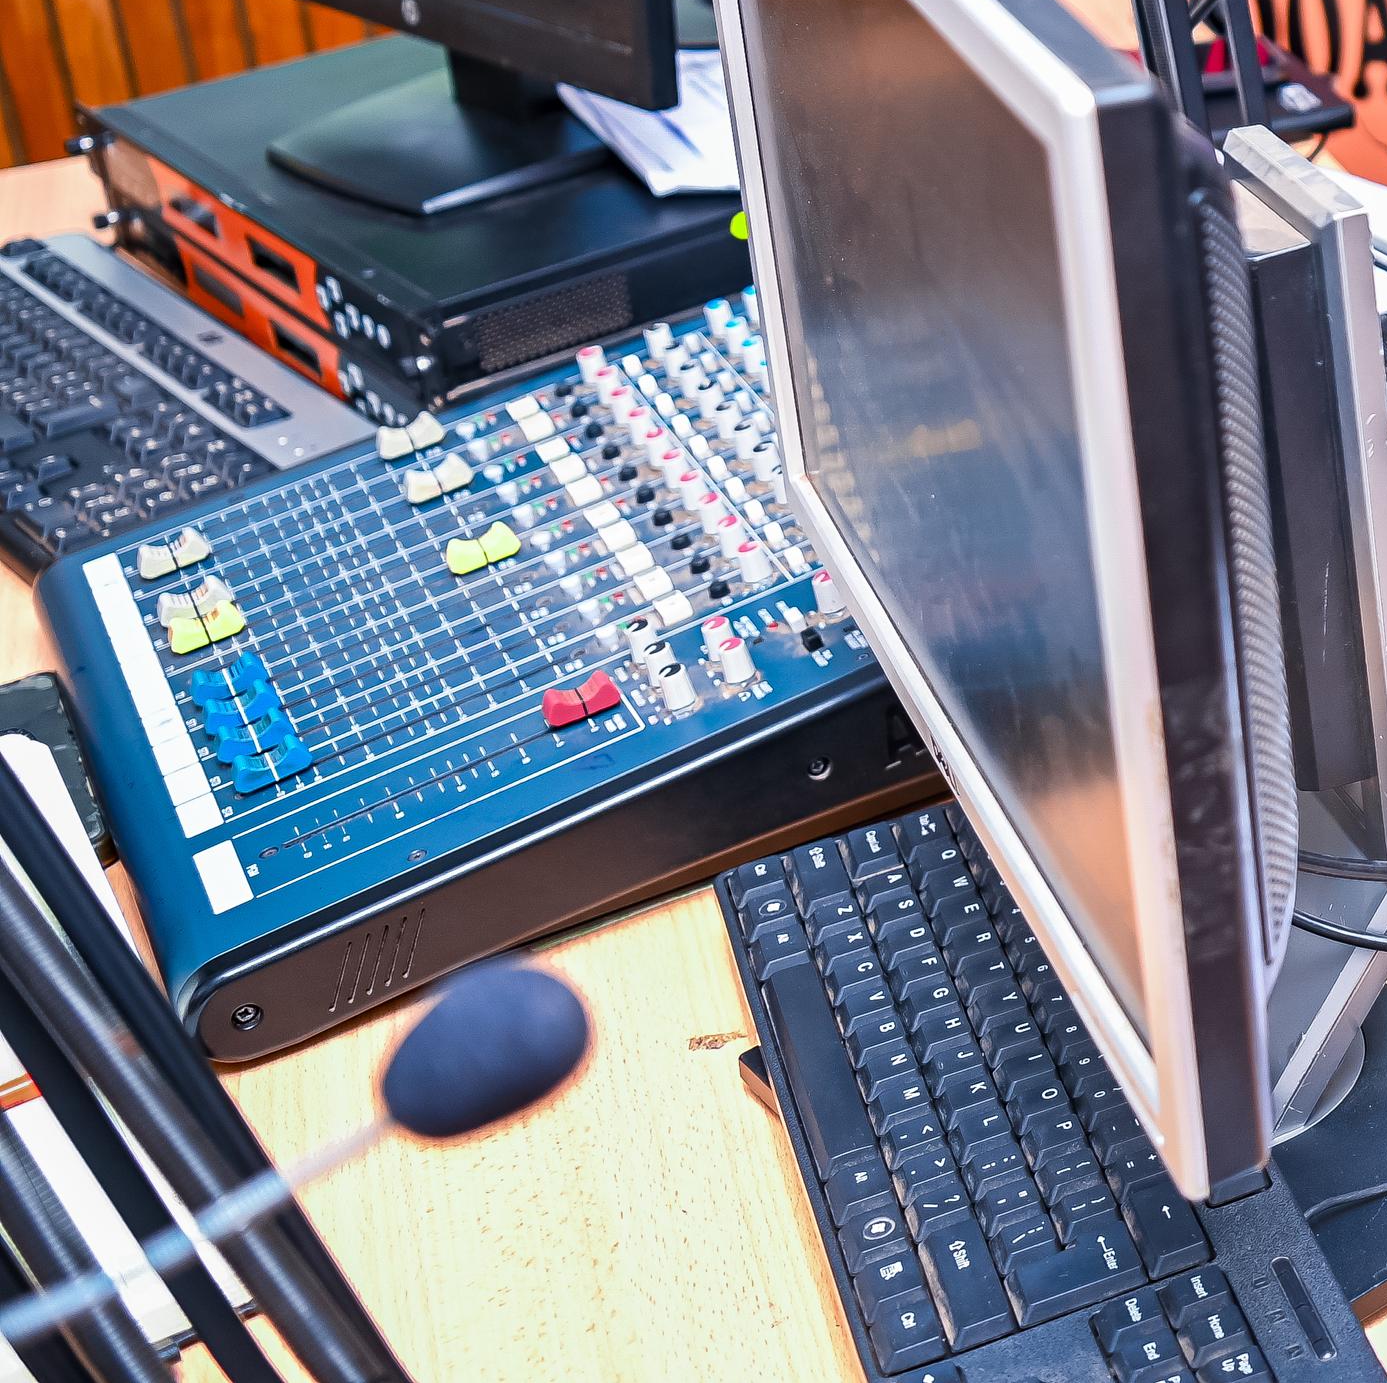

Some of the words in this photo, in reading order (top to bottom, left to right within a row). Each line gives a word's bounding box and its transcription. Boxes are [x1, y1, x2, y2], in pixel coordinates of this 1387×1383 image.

[941, 849, 957, 860] Q
[887, 874, 903, 884] A
[952, 875, 969, 888] W
[898, 899, 914, 909] S
[964, 903, 980, 914] E
[837, 904, 854, 916] Z
[846, 931, 864, 944] X
[909, 927, 926, 938] D
[976, 931, 992, 943] R
[1023, 935, 1037, 945] 5
[857, 961, 874, 972] C
[921, 957, 938, 966] F
[989, 961, 1005, 971] T
[1037, 964, 1049, 972] 6
[869, 990, 885, 1001] V
[932, 987, 950, 999] G
[1002, 991, 1018, 1001] Y
[879, 1021, 896, 1033] B
[944, 1017, 962, 1029] H
[1014, 1022, 1031, 1033] U
[1065, 1025, 1078, 1033] 8
[890, 1053, 908, 1066] N
[957, 1051, 974, 1059] J
[1028, 1053, 1043, 1061] I
[1078, 1057, 1091, 1065] 9
[902, 1086, 921, 1100] M
[969, 1081, 987, 1094] K
[1041, 1088, 1058, 1100] O
[1093, 1090, 1106, 1098] 0
[982, 1115, 999, 1127] L
[1056, 1120, 1073, 1130] P
[950, 1246, 970, 1270] Shift
[1102, 1246, 1119, 1270] Enter
[1190, 1275, 1209, 1299] Insert
[1124, 1297, 1142, 1322] Delete
[1207, 1314, 1225, 1340] Home
[1142, 1341, 1161, 1361] End
